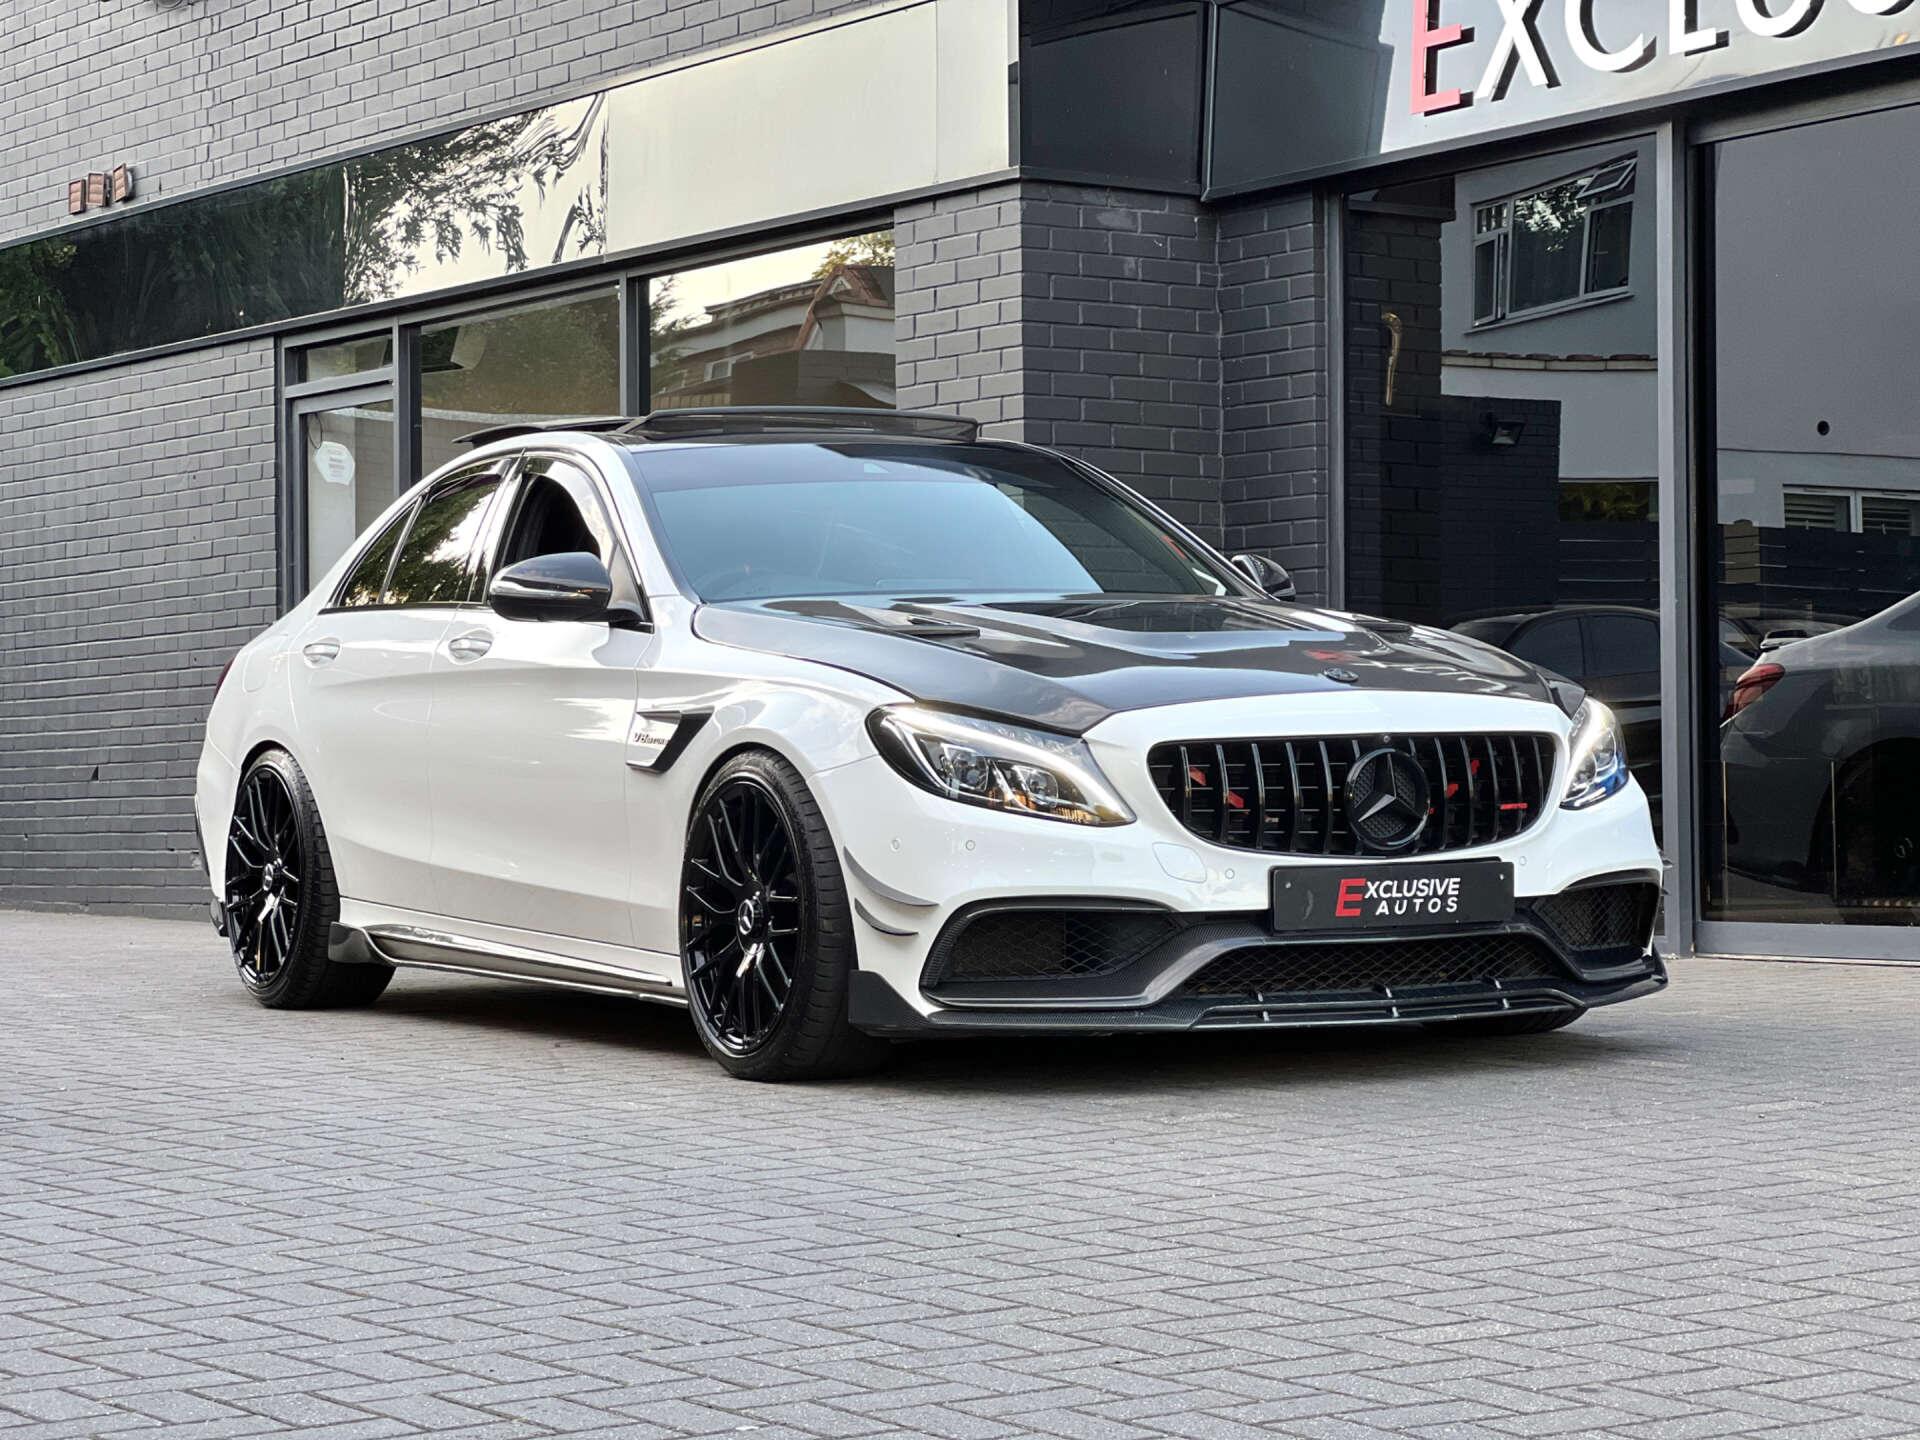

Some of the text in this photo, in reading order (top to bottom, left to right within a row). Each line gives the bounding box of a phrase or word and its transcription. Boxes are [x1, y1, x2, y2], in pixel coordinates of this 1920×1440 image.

[1410, 0, 1901, 114] EXCL
[1335, 878, 1461, 917] EXCLUSIVE
[1375, 897, 1458, 915] AUTOS
